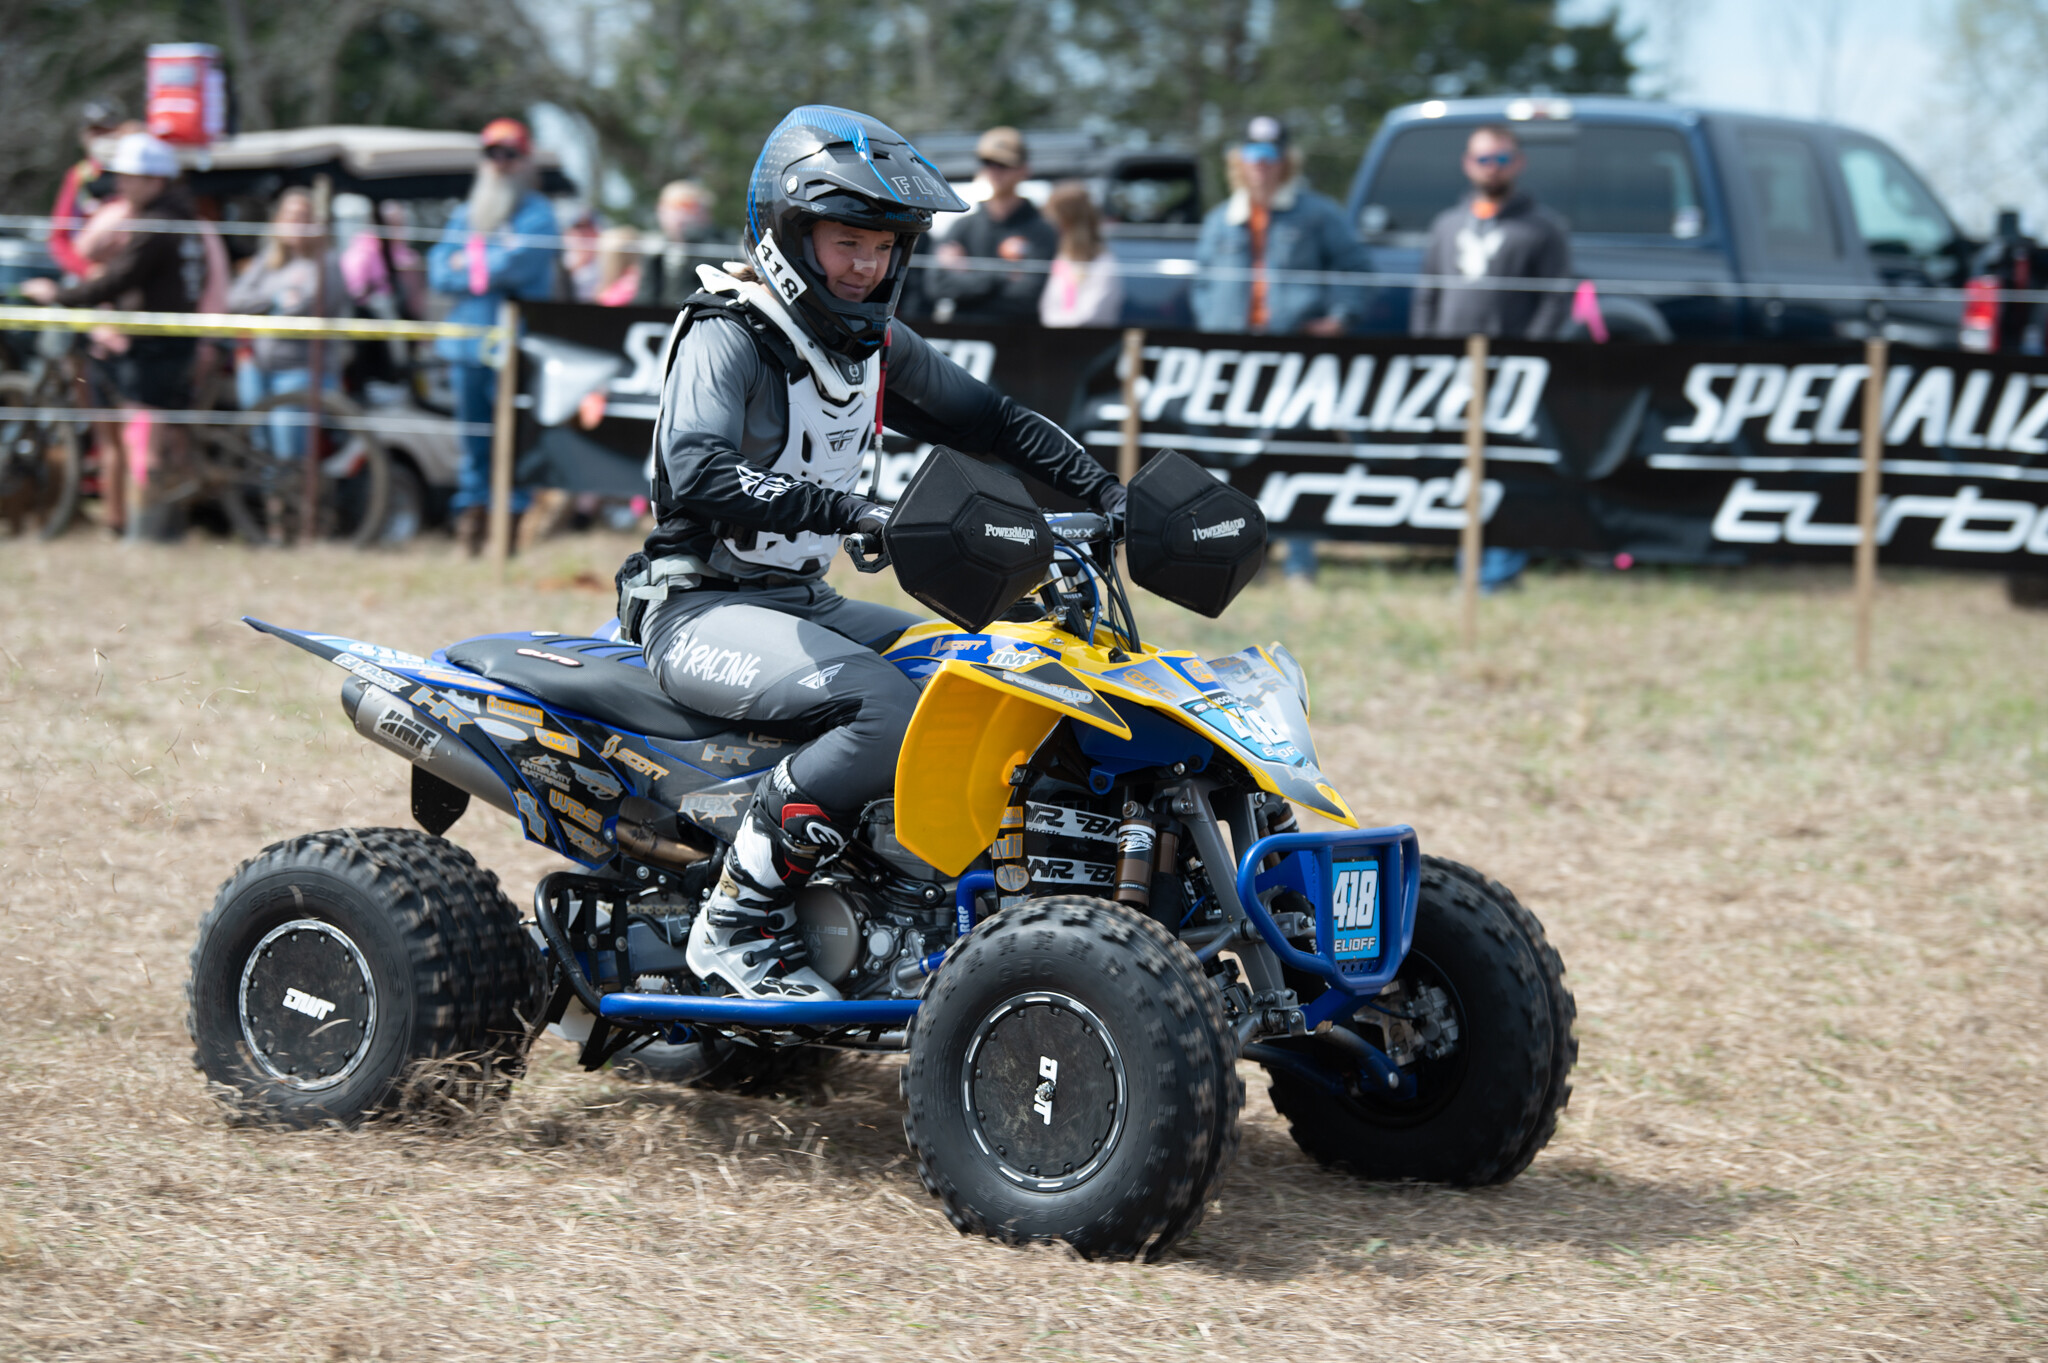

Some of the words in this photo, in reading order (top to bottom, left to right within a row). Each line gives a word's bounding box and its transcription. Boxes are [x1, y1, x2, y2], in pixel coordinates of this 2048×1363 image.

[891, 176, 946, 197] FLY
[760, 243, 799, 299] 418
[942, 640, 987, 651] SCOTT
[683, 644, 761, 688] RACING
[613, 747, 670, 781] SCOTT
[1333, 869, 1378, 930] 418
[1334, 936, 1377, 953] ELIOFF
